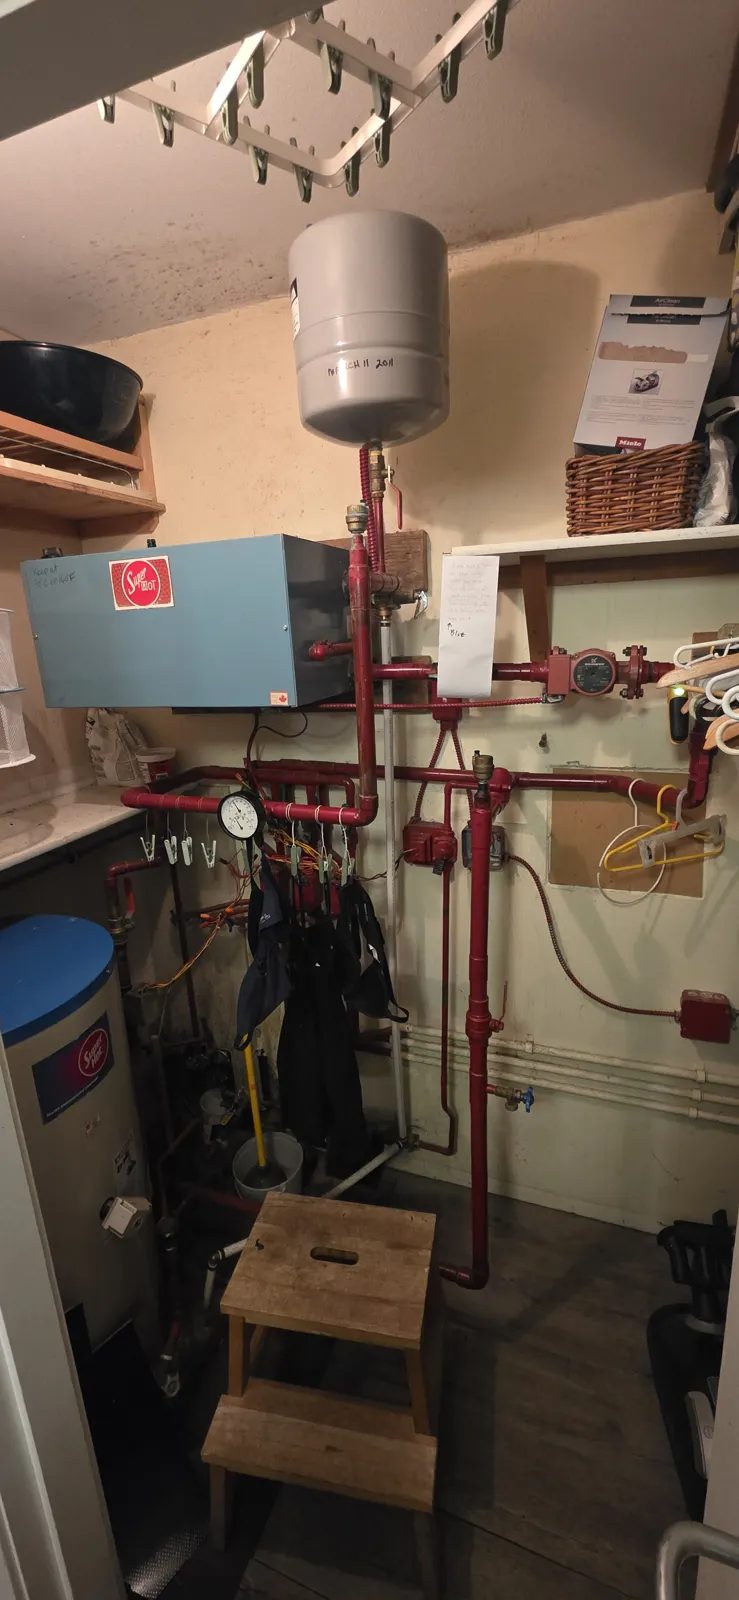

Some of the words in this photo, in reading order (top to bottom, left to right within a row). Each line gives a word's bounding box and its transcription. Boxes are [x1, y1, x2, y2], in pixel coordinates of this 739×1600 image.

[363, 359, 369, 368] 11
[375, 358, 394, 369] 2011
[618, 439, 643, 447] Miele
[126, 567, 147, 595] Super
[84, 1033, 103, 1070] Super
